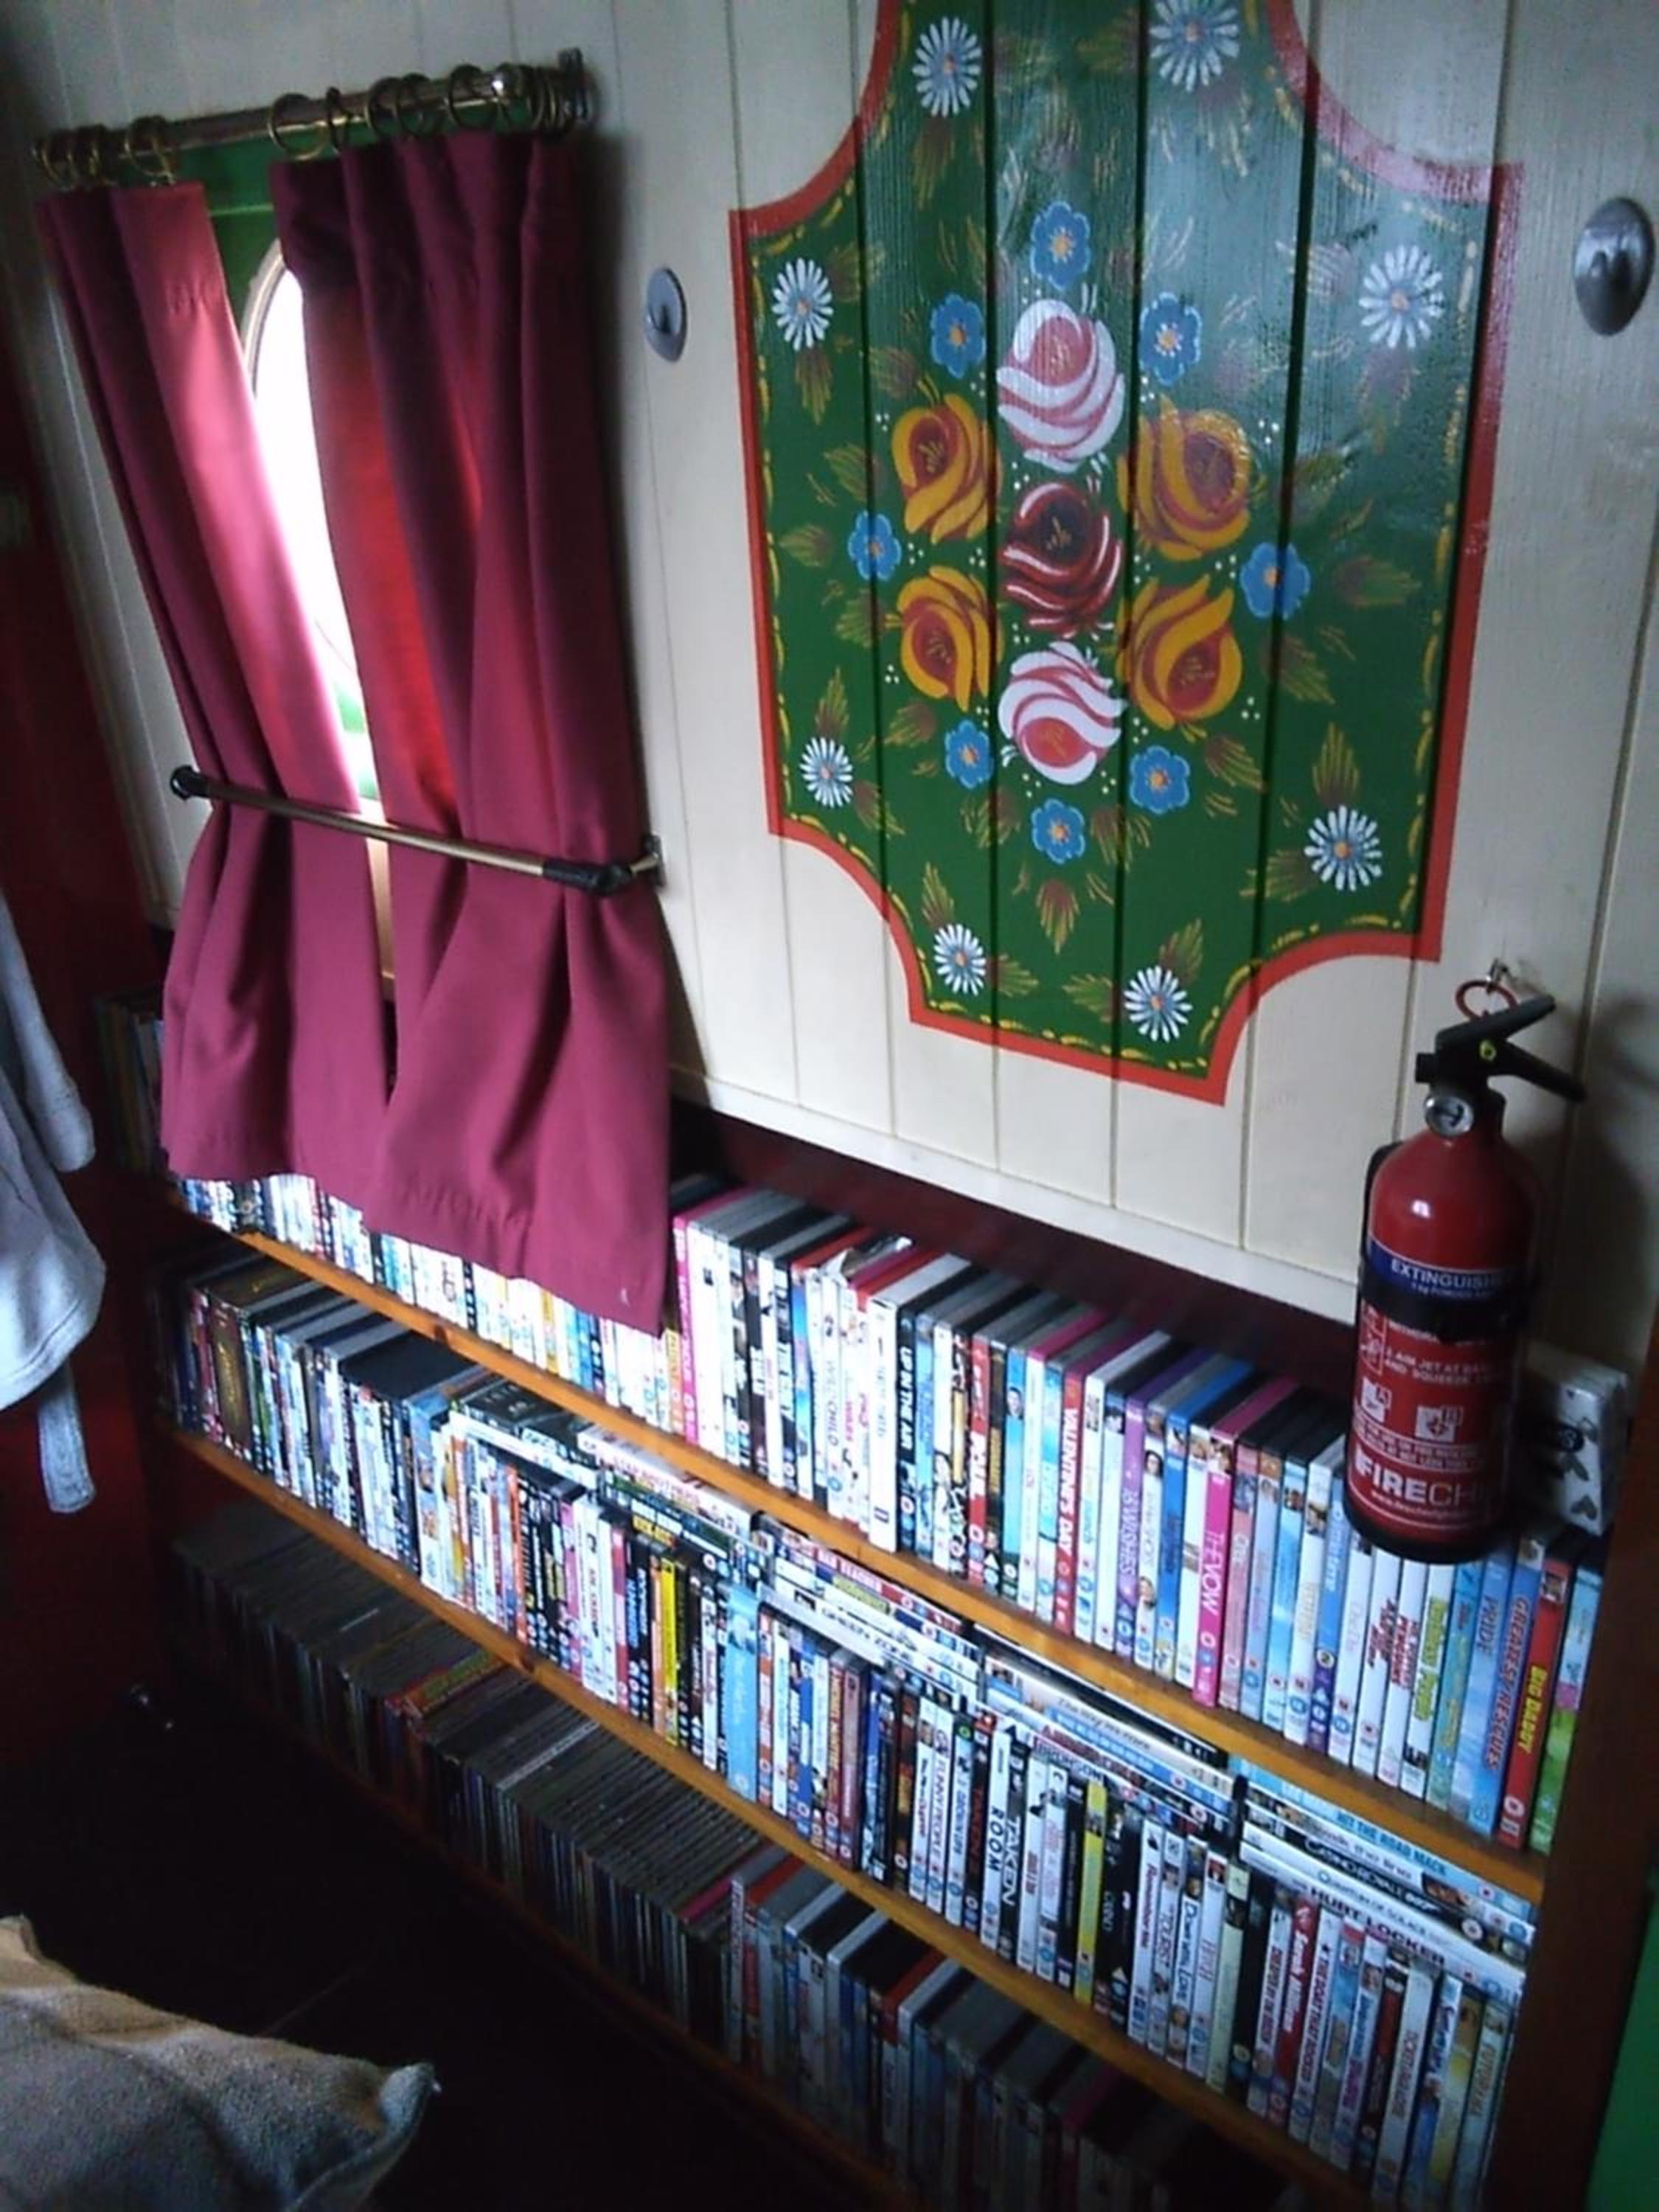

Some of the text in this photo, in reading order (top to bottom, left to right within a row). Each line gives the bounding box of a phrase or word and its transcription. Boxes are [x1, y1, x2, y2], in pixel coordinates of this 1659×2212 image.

[1391, 1259, 1506, 1287] EXTINGUISH
[825, 1400, 838, 1448] CHILD
[900, 1347, 912, 1450] UP IN THE AIR
[1057, 1518, 1072, 1555] DAY
[1119, 1504, 1137, 1576] WISHES
[1200, 1530, 1223, 1615] THE VOW
[1474, 1594, 1501, 1658] PRIDE
[1483, 1596, 1531, 1771] GREATEST RESCUES
[1515, 1696, 1542, 1756] DADDY
[930, 1807, 943, 1860] PEOPLE
[985, 1804, 1004, 1872] ROOM
[1000, 1815, 1020, 1906] TAKEN
[1354, 1821, 1380, 1840] THE
[1377, 1834, 1413, 1857] ROAD
[1411, 1851, 1450, 1877] MACK
[1141, 1863, 1160, 1927] Remember
[1182, 1902, 1197, 1941] Down
[1308, 1886, 1365, 1923] HURT
[1364, 1916, 1447, 1966] LOCKER
[1173, 1969, 1192, 2010] Love
